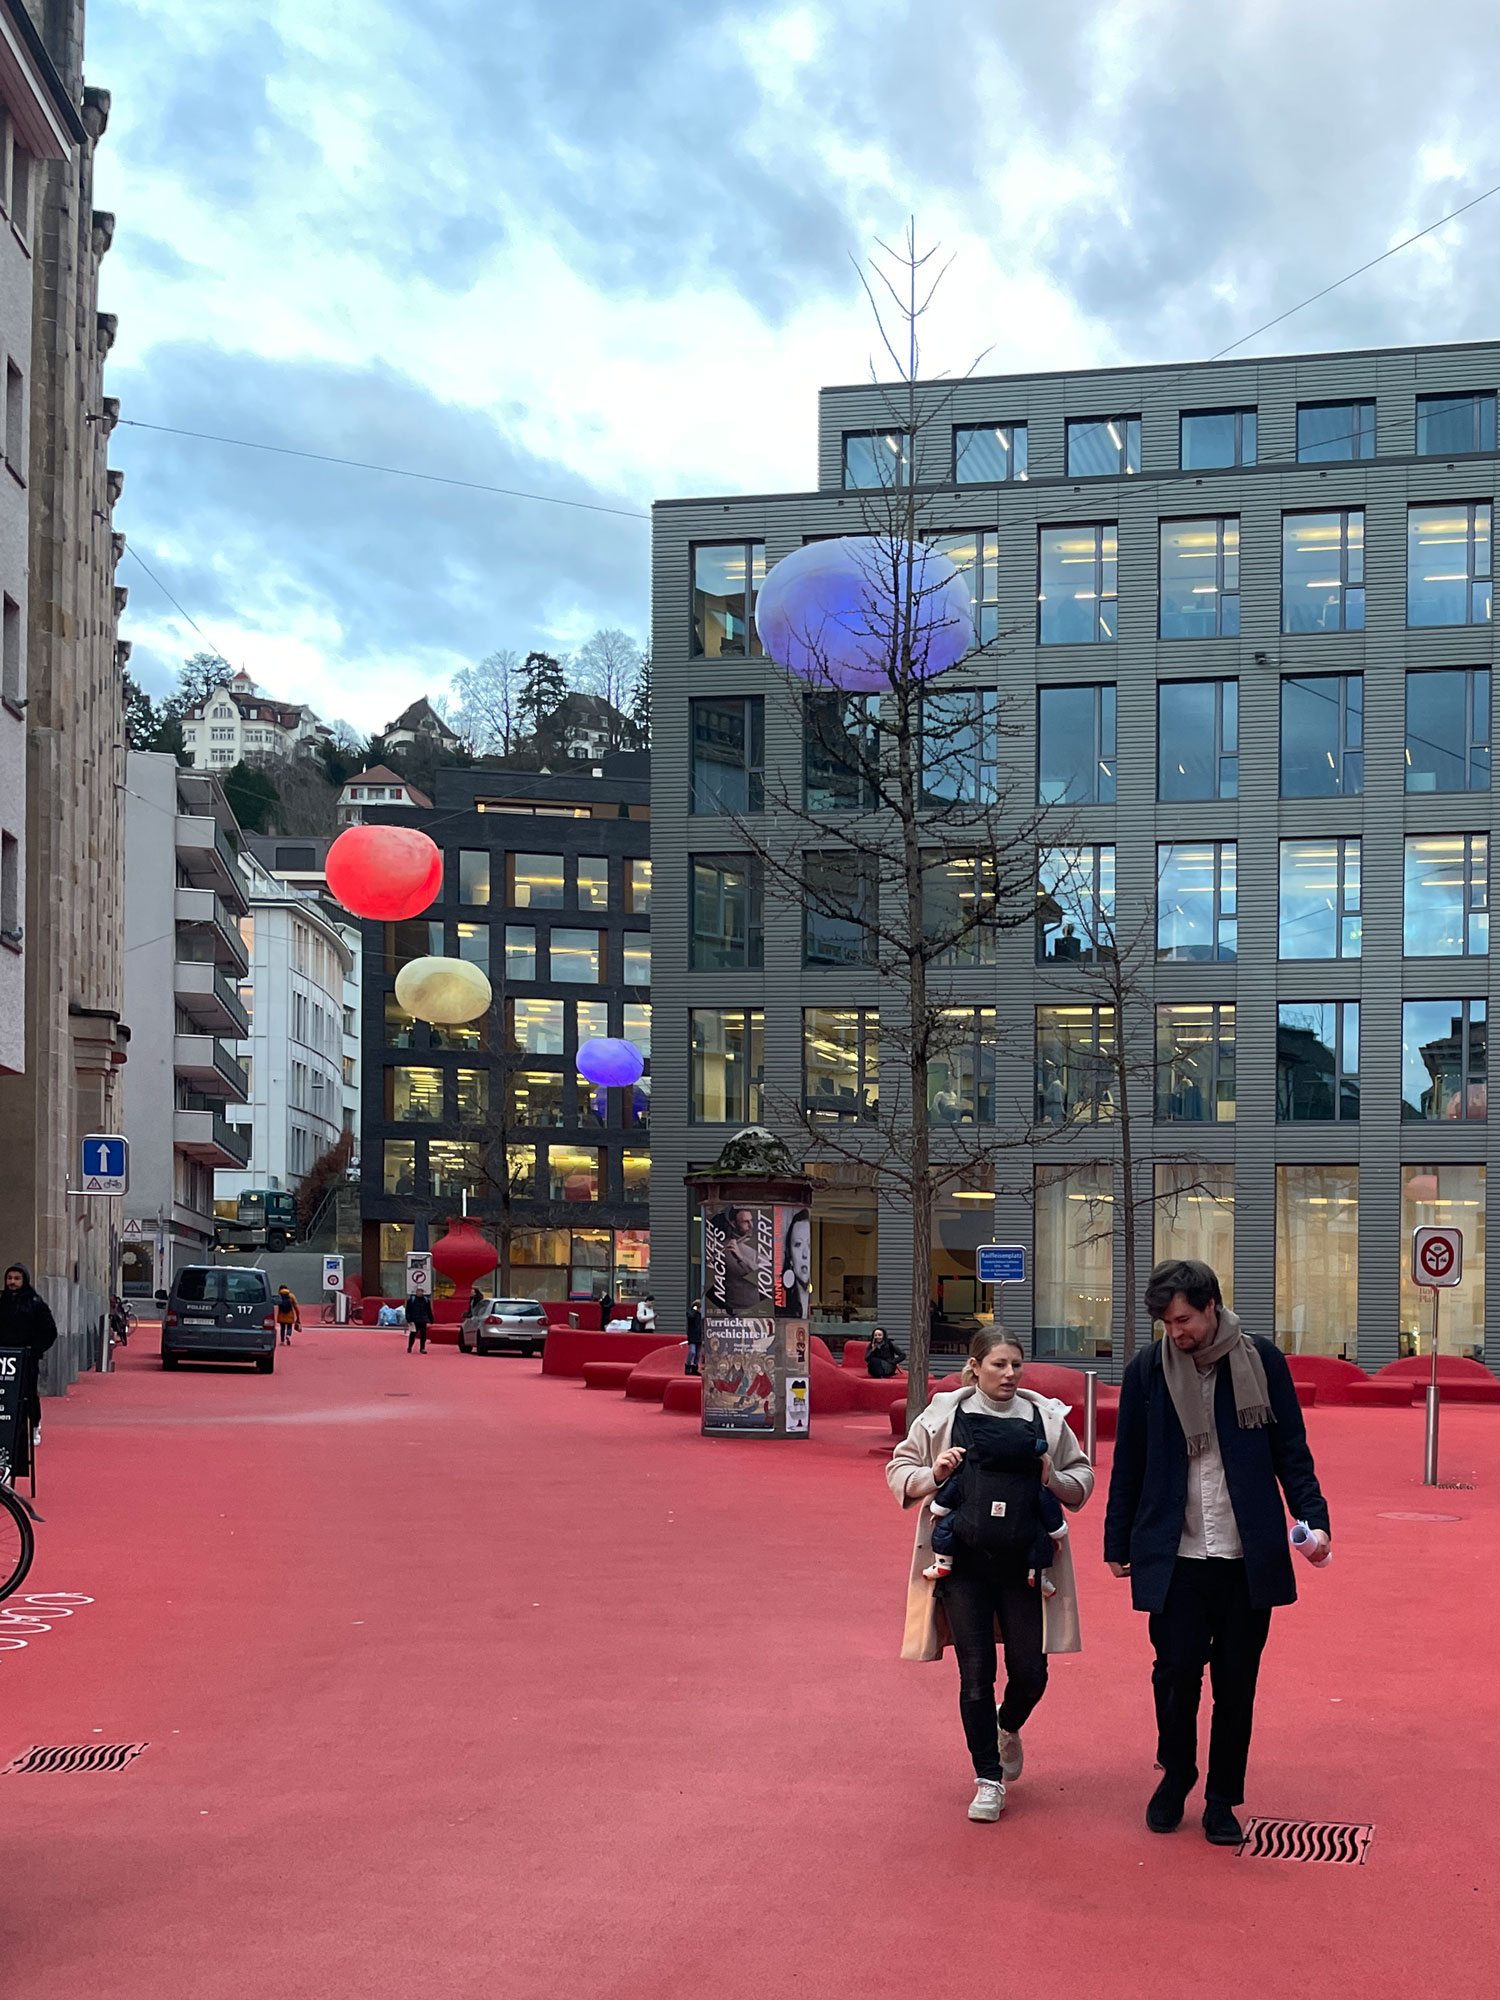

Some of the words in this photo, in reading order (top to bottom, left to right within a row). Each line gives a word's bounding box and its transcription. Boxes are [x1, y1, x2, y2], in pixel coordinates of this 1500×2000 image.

[714, 1227, 726, 1302] NACHTS
[757, 1210, 773, 1299] KONZERT
[774, 1277, 784, 1308] ANNE
[237, 1305, 253, 1315] 117
[706, 1317, 753, 1327] Verrückte
[706, 1329, 768, 1339] Geschichten
